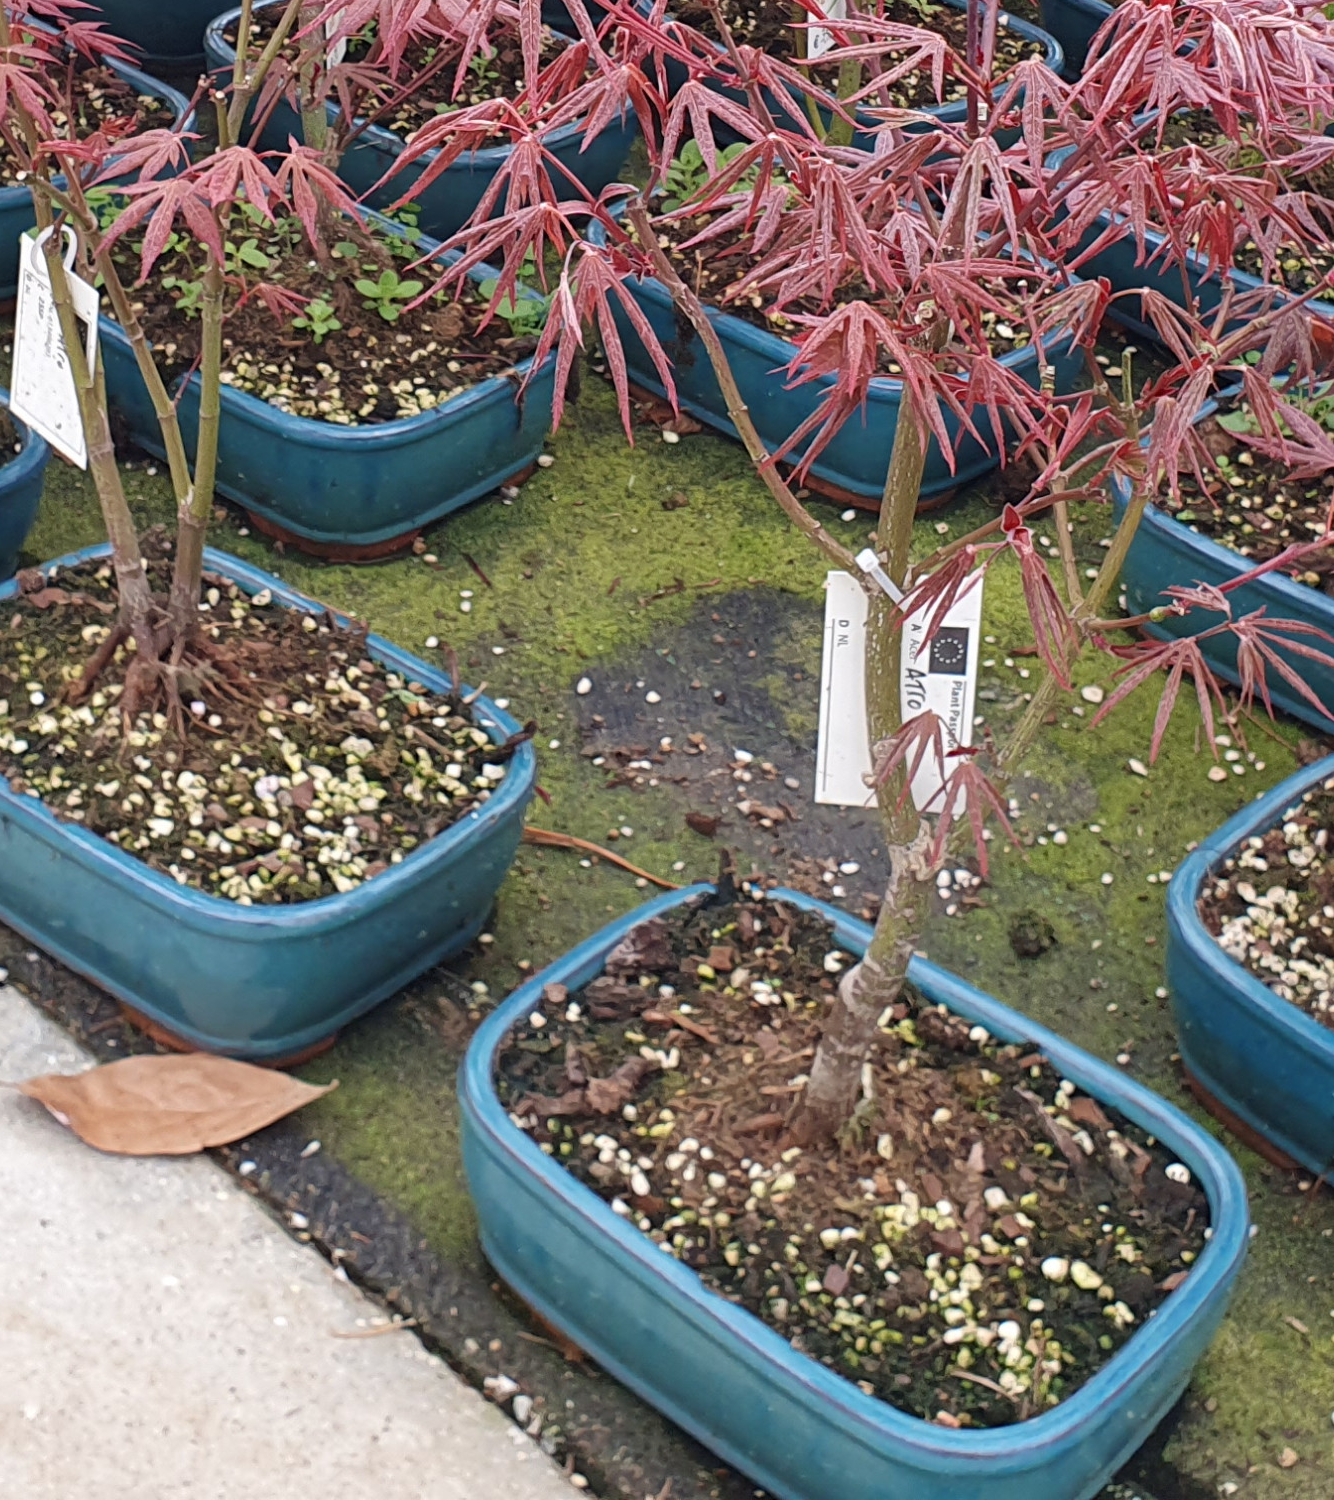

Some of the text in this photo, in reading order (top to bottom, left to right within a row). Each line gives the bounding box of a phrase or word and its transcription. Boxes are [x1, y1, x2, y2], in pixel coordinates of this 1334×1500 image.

[836, 619, 849, 648] D NL
[909, 638, 922, 661] Acer
[945, 679, 963, 749] Plant Passpor
